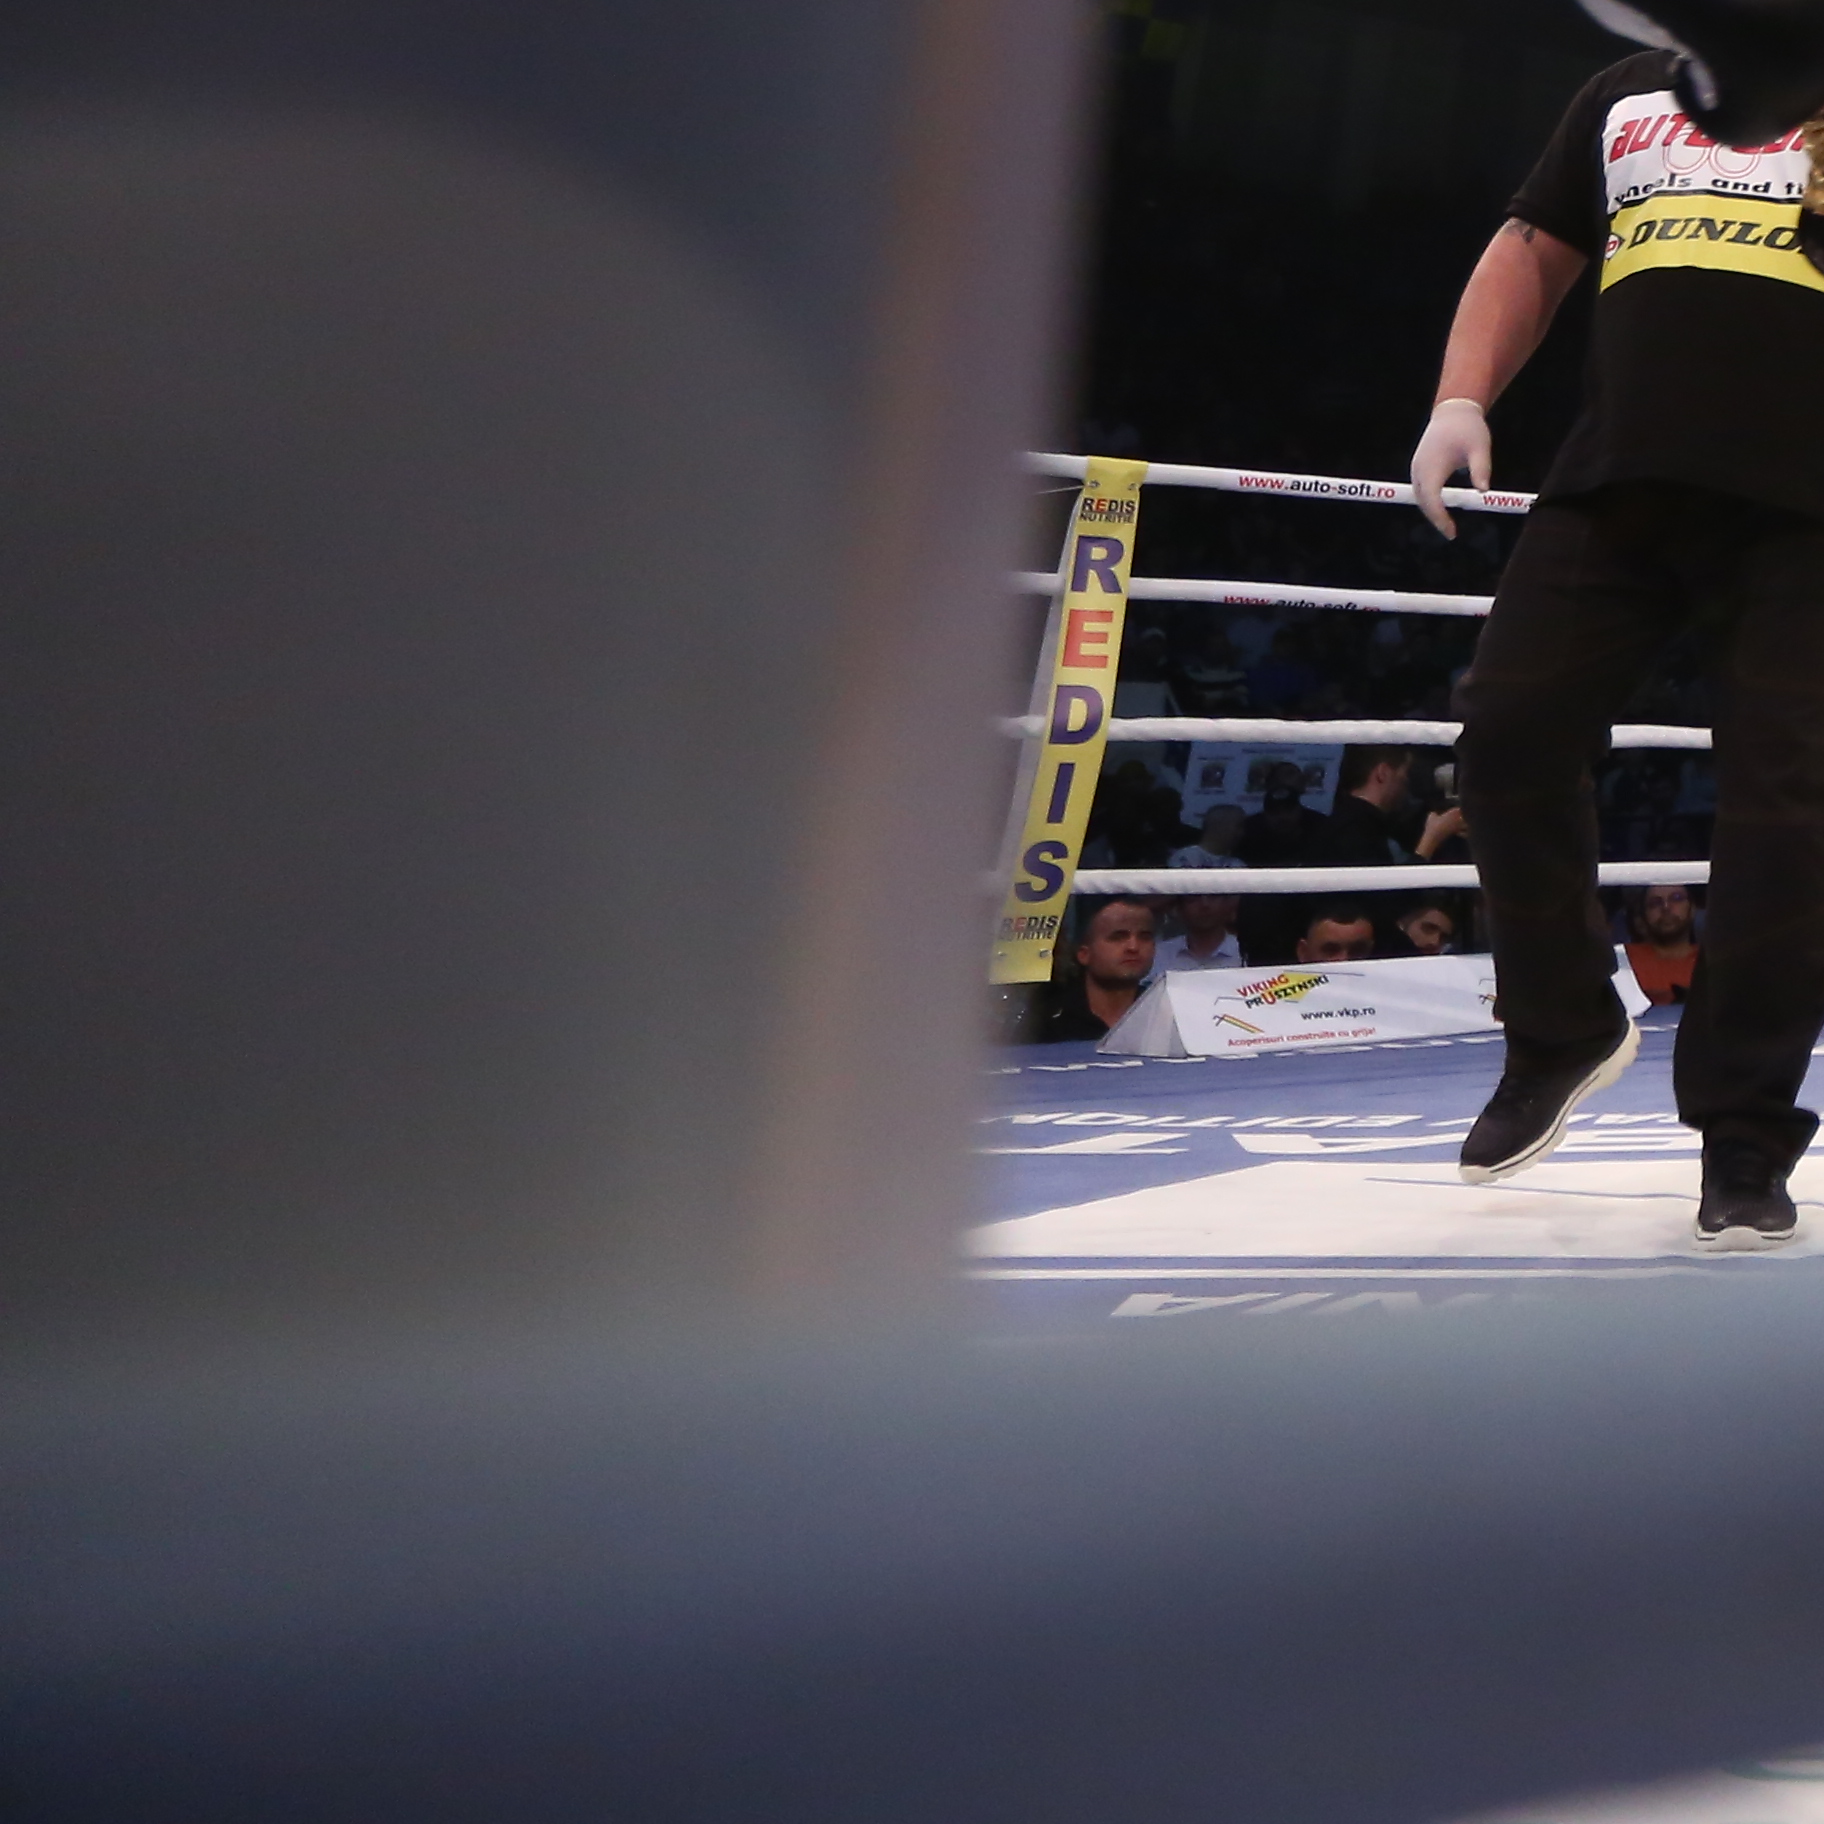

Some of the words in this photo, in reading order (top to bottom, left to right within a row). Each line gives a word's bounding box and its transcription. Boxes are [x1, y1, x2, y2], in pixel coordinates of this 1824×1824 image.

[1711, 178, 1770, 194] and
[1627, 217, 1804, 253] DUNLO
[1238, 474, 1396, 500] www.auto-soft.ro
[1081, 496, 1136, 514] REDIS
[1012, 533, 1125, 904] REDIS
[1237, 974, 1290, 998] VIKING
[1300, 1007, 1377, 1021] www.vkp.ro
